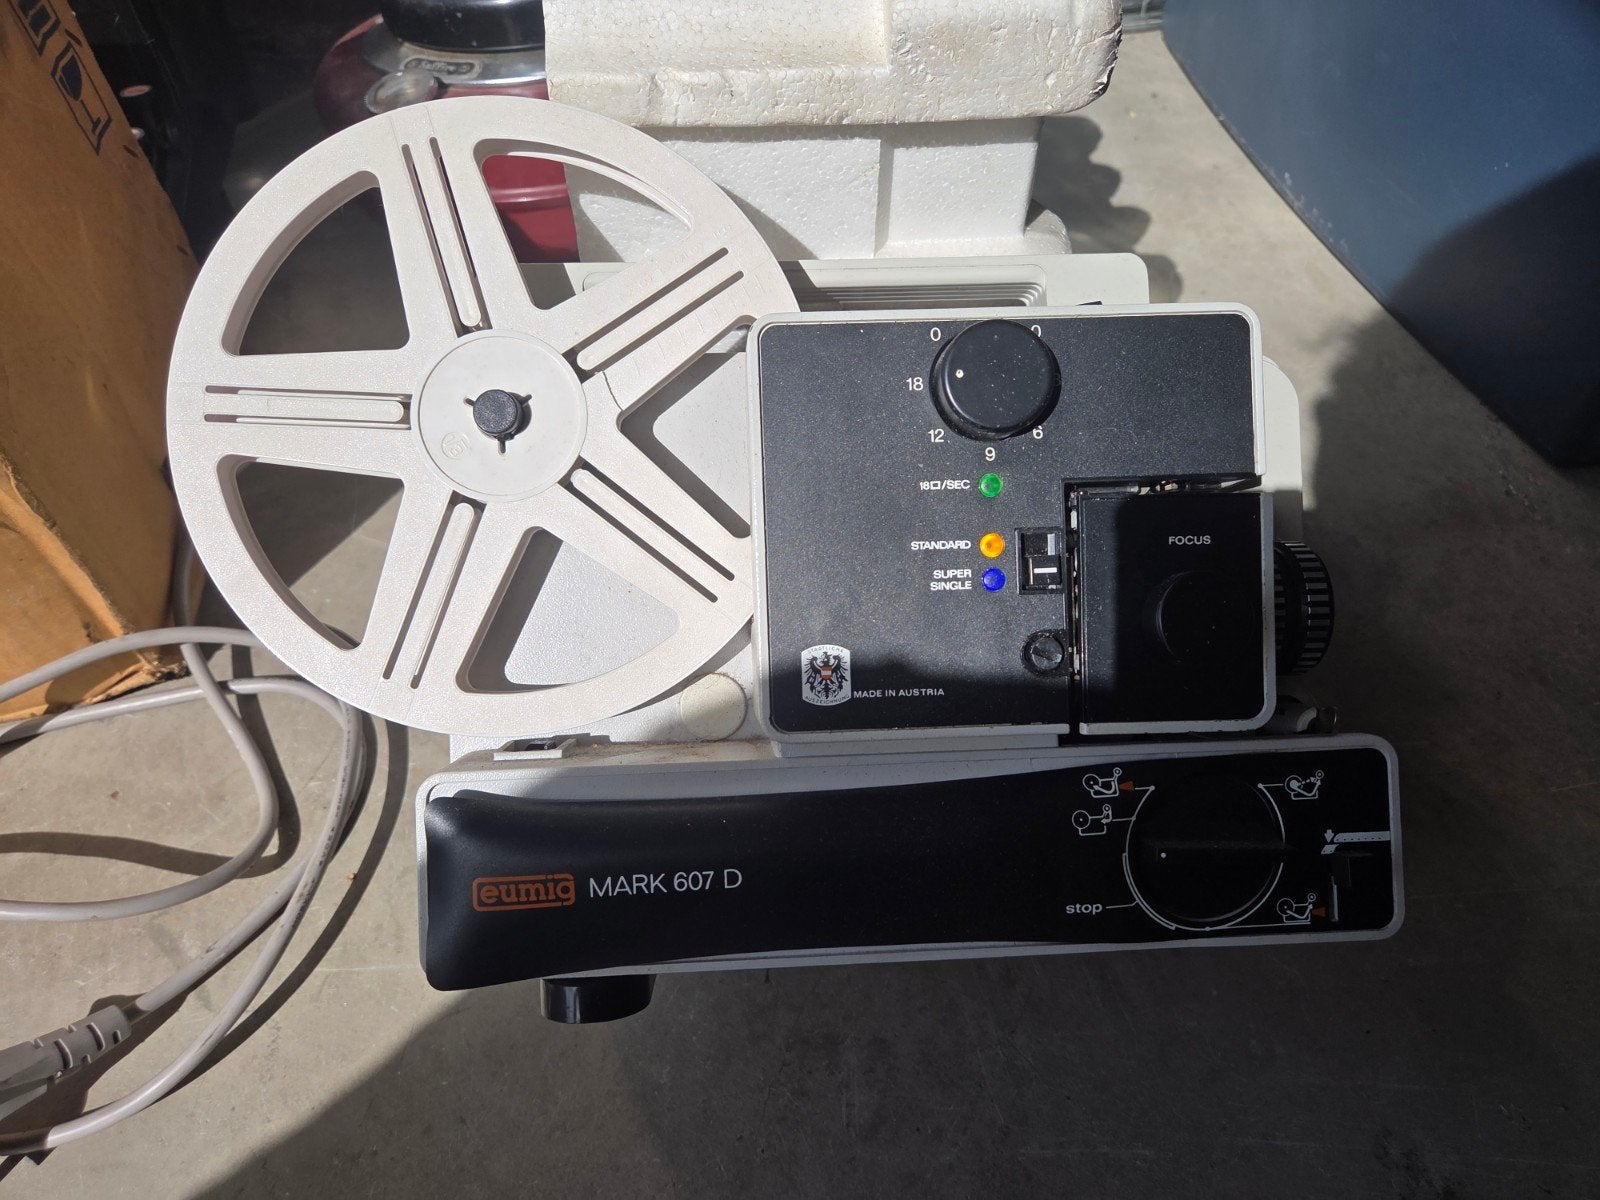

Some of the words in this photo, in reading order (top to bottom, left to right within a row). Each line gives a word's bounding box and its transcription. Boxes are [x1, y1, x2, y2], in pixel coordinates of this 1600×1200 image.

[930, 327, 941, 341] 0
[906, 377, 923, 391] 18
[928, 429, 944, 443] 12
[1033, 425, 1043, 439] 6
[985, 447, 995, 461] 9
[911, 540, 971, 550] STANDARD
[1168, 535, 1211, 545] FOCUS
[933, 569, 972, 579] SUPER
[930, 581, 972, 591] SINGLE
[854, 690, 882, 698] MADE
[885, 689, 896, 697] IN
[899, 687, 945, 697] AUSTRIA
[589, 873, 667, 898] MARK
[673, 870, 714, 892] 607
[723, 868, 743, 889] D
[480, 874, 576, 907] eumig
[1065, 902, 1103, 915] stop
